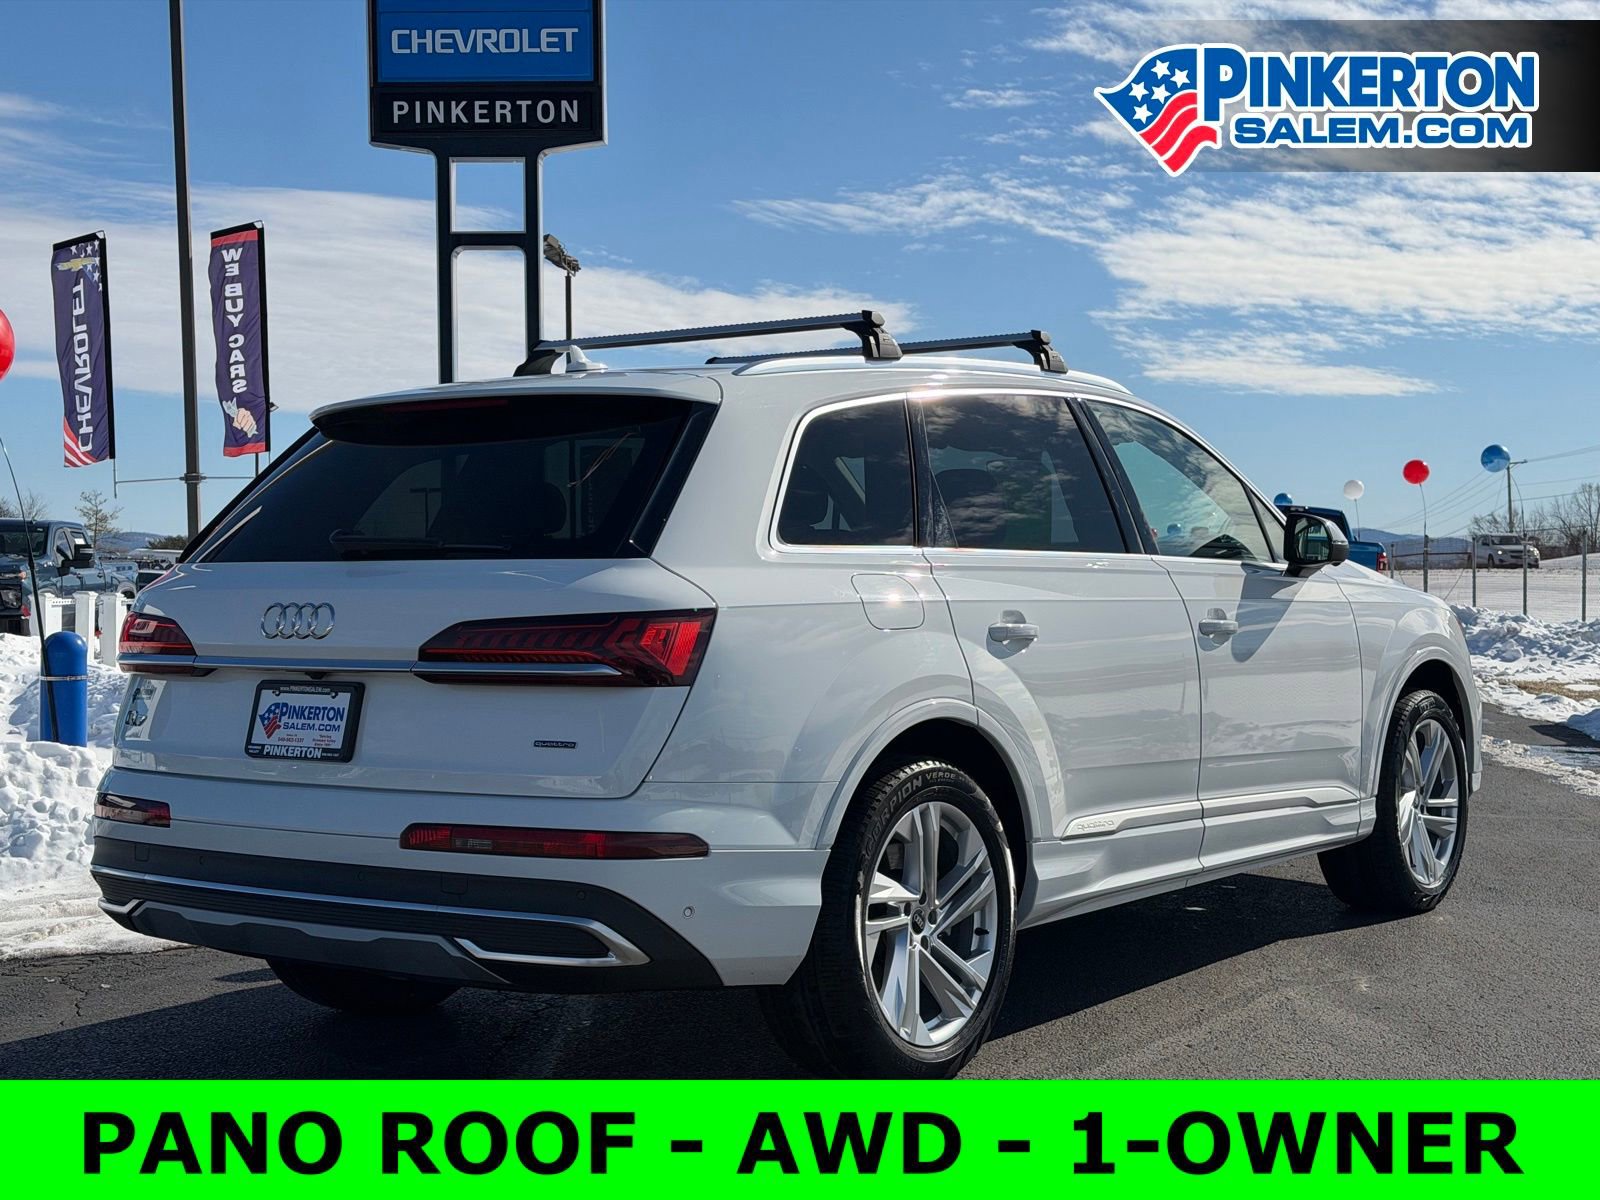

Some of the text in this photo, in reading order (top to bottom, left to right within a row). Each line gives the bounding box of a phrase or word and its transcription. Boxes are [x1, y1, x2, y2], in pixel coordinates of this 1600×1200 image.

[391, 27, 579, 54] CHEVROLET
[392, 99, 579, 124] PINKERTON
[279, 702, 345, 722] PINKERTON
[282, 721, 341, 732] SALEM.COM
[263, 745, 322, 759] PINKERTON
[925, 771, 956, 780] VERDE
